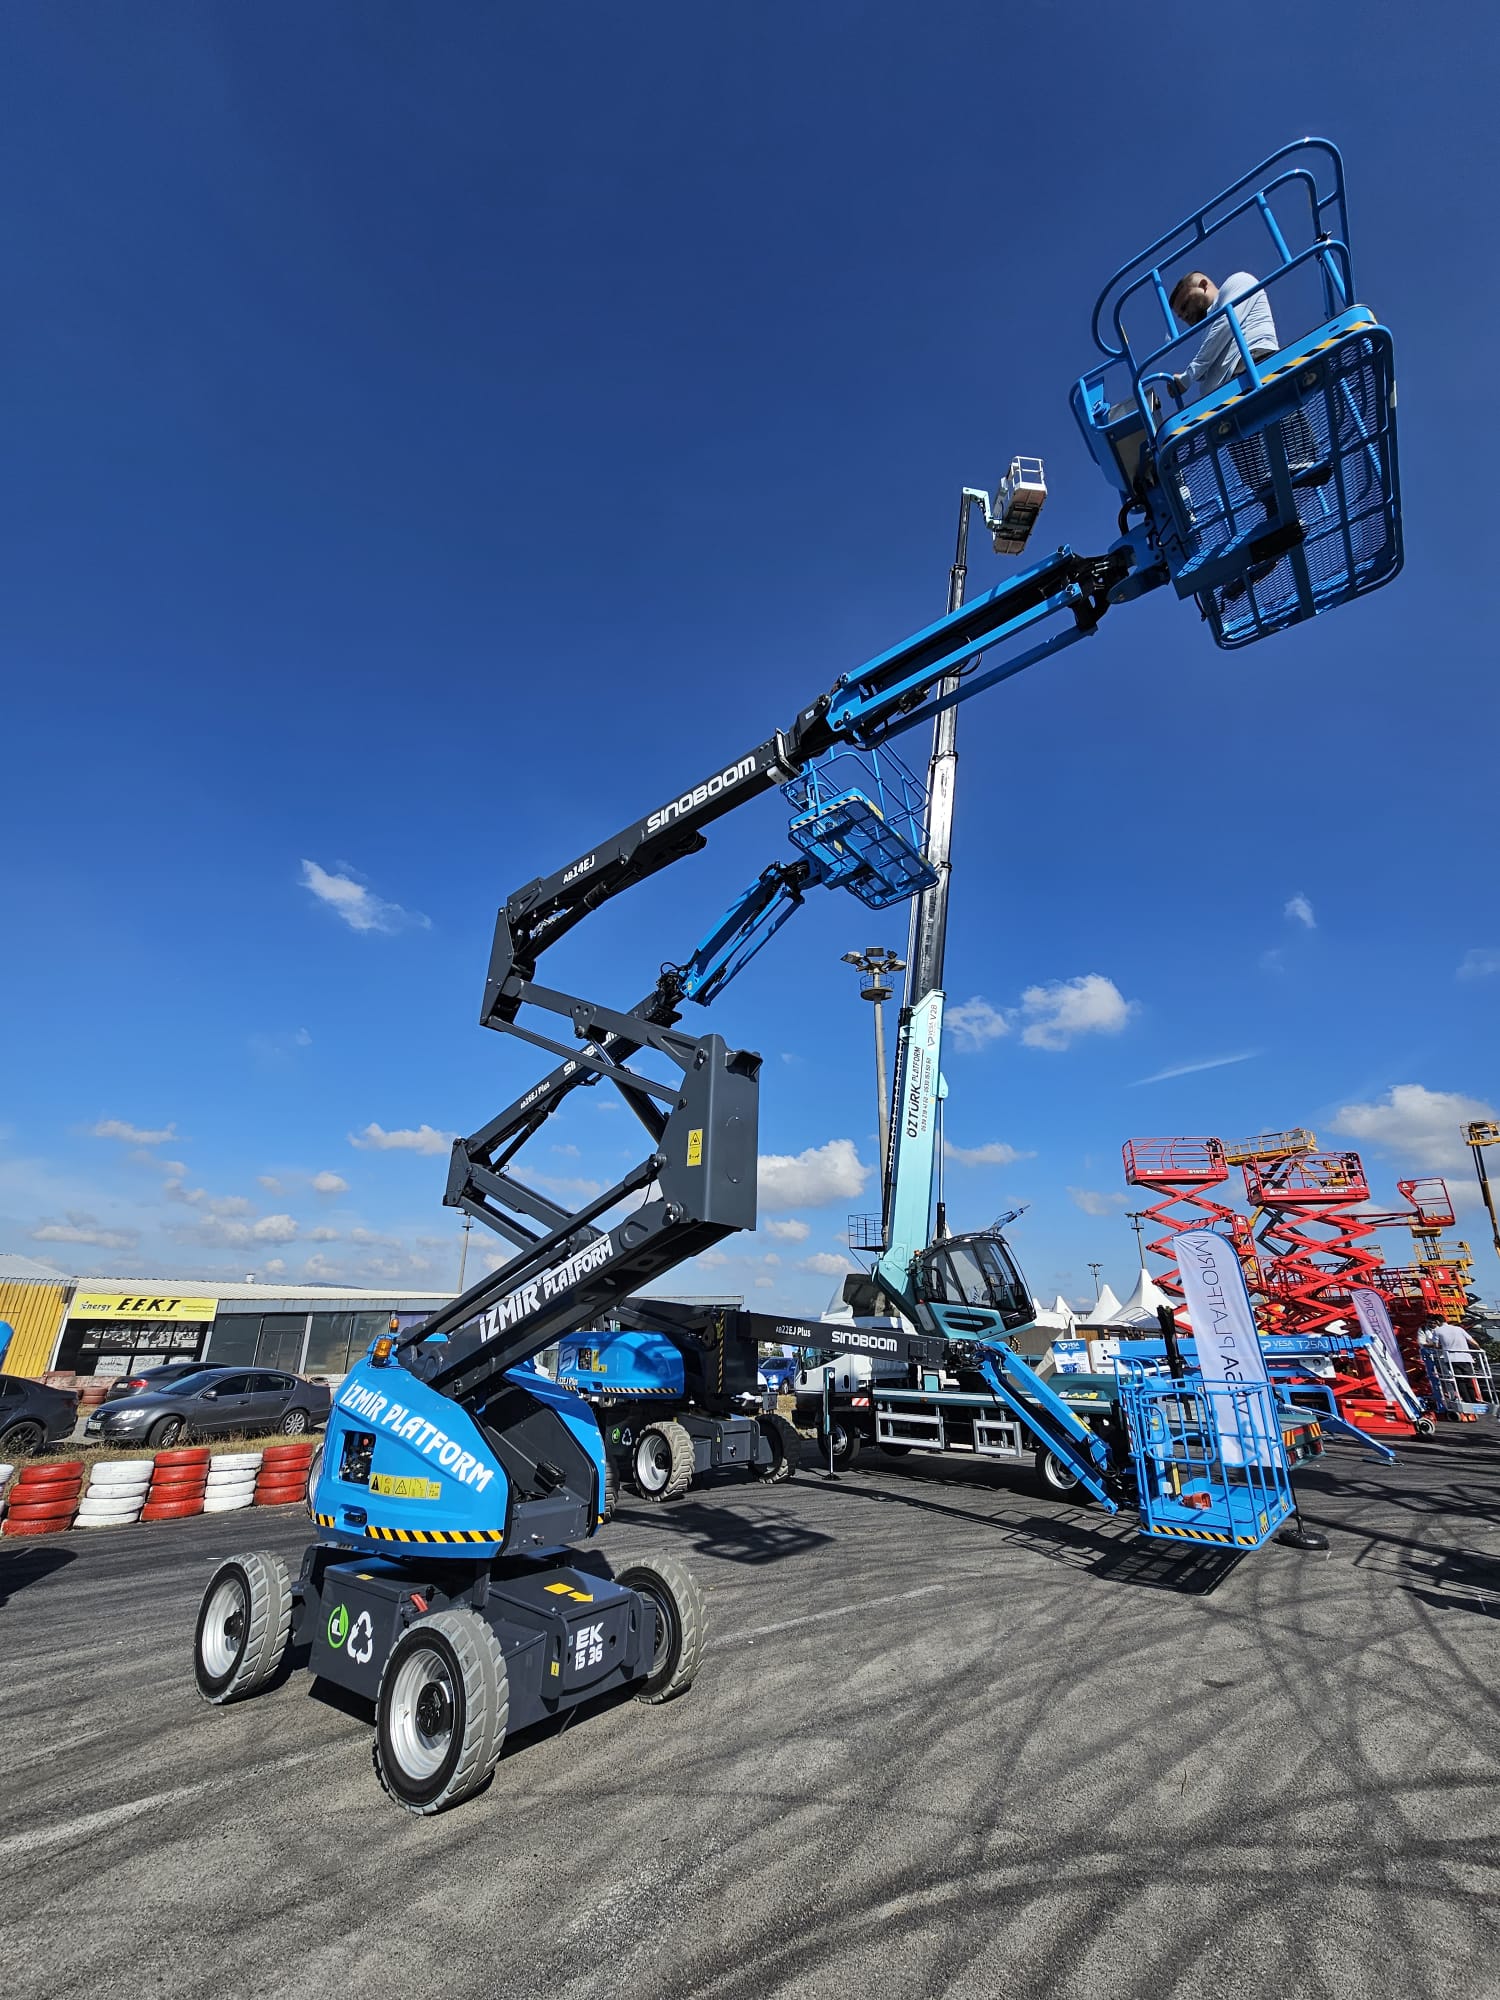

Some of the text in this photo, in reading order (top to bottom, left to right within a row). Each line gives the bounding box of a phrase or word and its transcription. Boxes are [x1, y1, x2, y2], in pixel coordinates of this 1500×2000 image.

[647, 756, 756, 834] SINOBOOM
[562, 854, 596, 885] AB14EJ
[906, 1046, 922, 1138] ÖZTÜRK PLATFORM
[543, 1236, 614, 1300] PLATFORM
[797, 1326, 811, 1338] Plus
[831, 1331, 898, 1352] SINOBOOM
[339, 1379, 494, 1493] İZMİR PLATFORM
[576, 1621, 604, 1650] EK
[575, 1643, 603, 1671] 15 36
